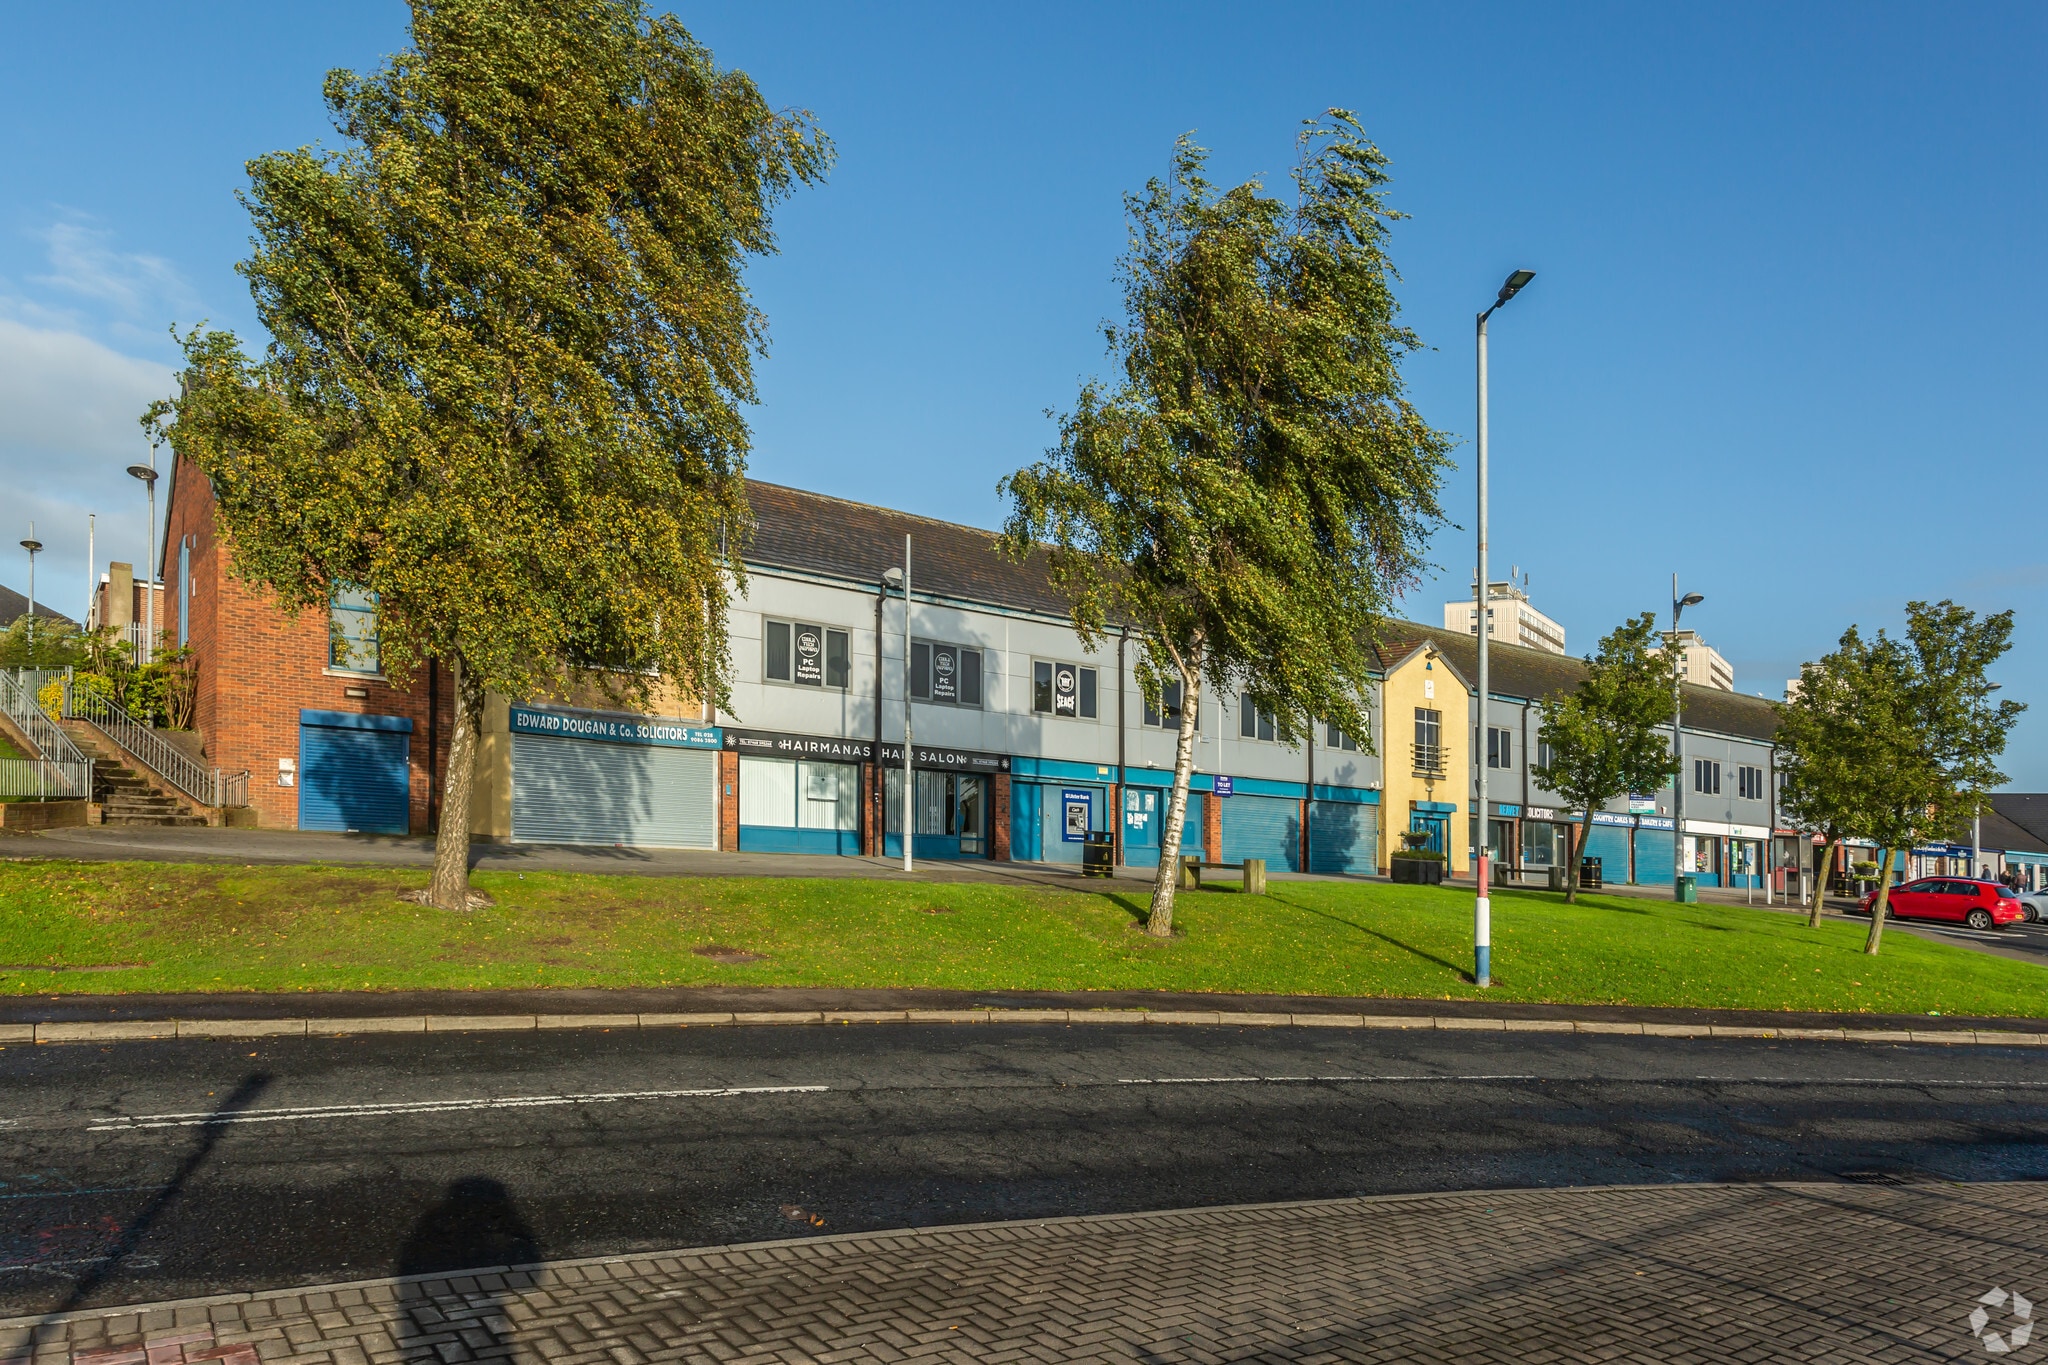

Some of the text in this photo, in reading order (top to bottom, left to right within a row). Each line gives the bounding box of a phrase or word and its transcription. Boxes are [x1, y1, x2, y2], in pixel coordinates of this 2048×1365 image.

[798, 665, 820, 674] Laptop
[797, 671, 821, 680] Repairs
[935, 683, 954, 691] Laptop
[517, 713, 688, 741] EDWARD DOUGAN & Co. SOLICITORS
[783, 739, 871, 757] HAIRMANAS
[919, 751, 963, 765] SALON
[1526, 806, 1554, 819] OLICITORS
[1593, 813, 1614, 823] COUNTRY
